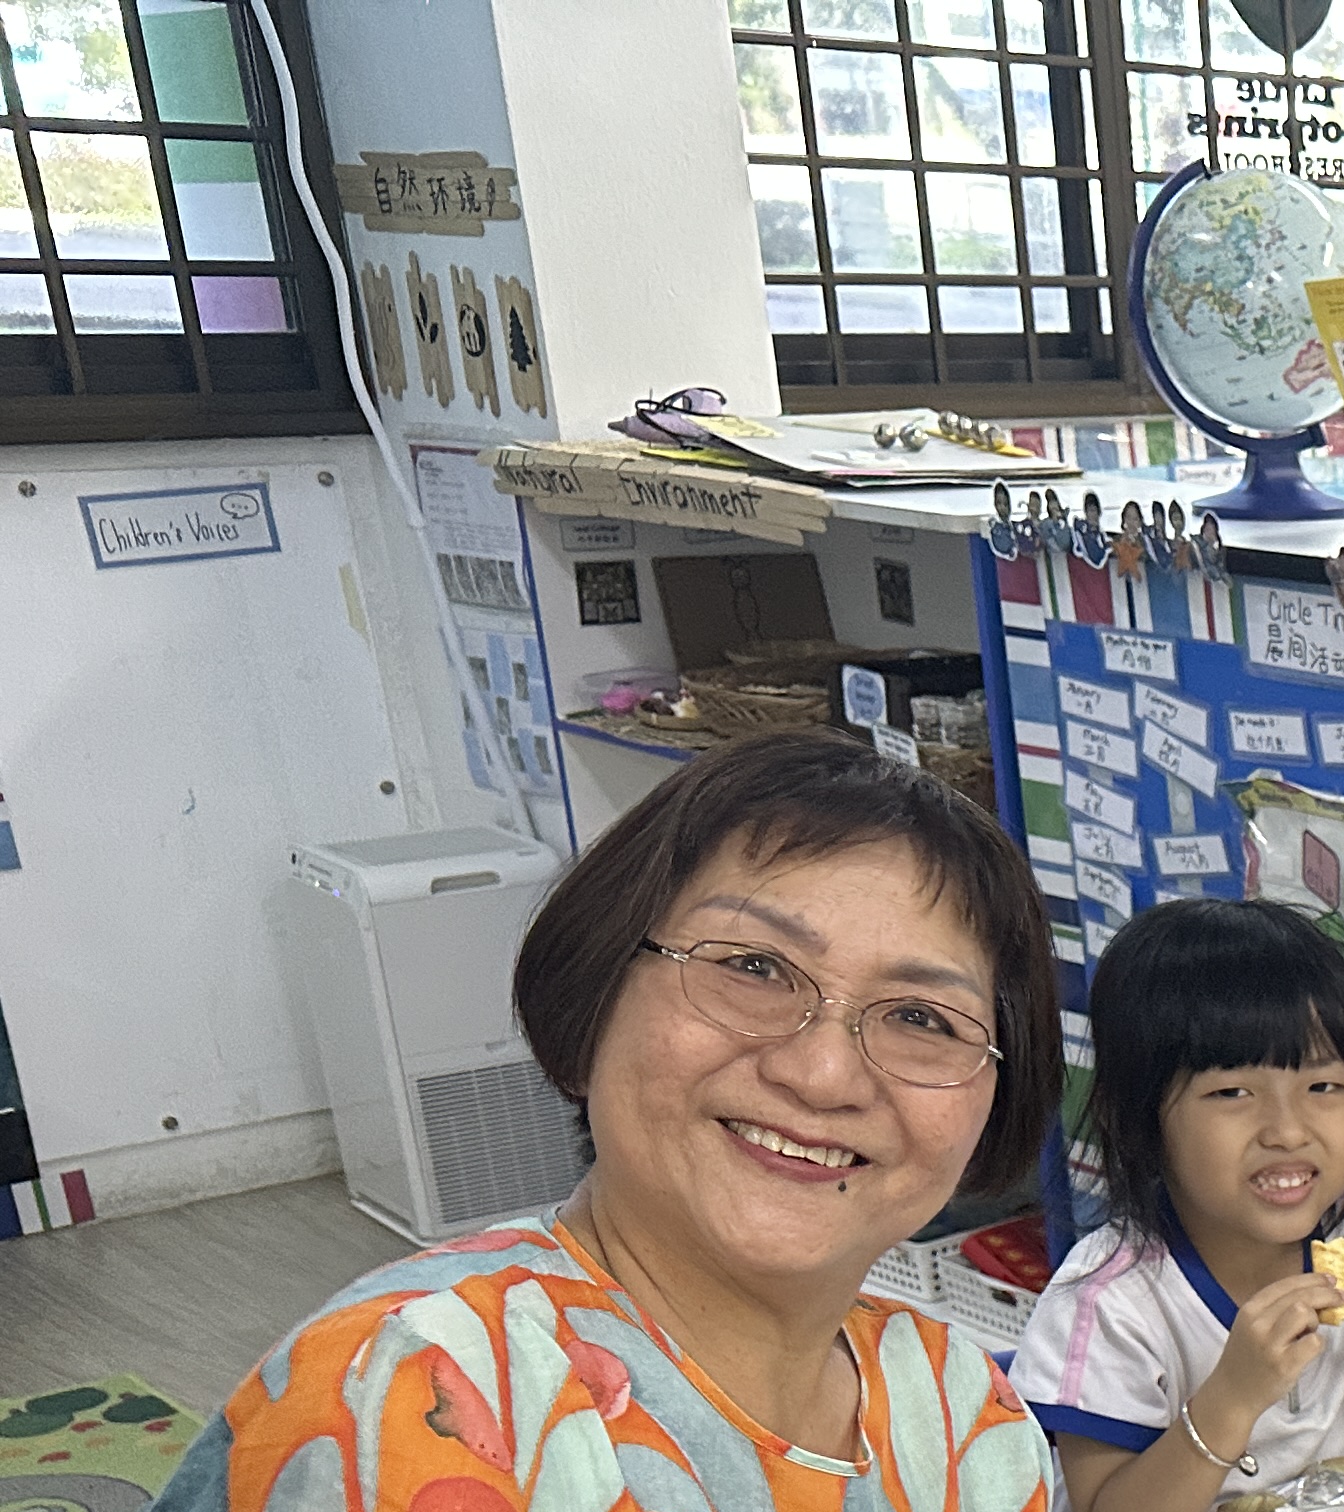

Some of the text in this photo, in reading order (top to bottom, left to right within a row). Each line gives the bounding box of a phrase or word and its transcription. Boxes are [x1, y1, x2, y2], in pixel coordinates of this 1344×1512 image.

[616, 458, 763, 519] Environment
[99, 511, 240, 554] Children's Voices
